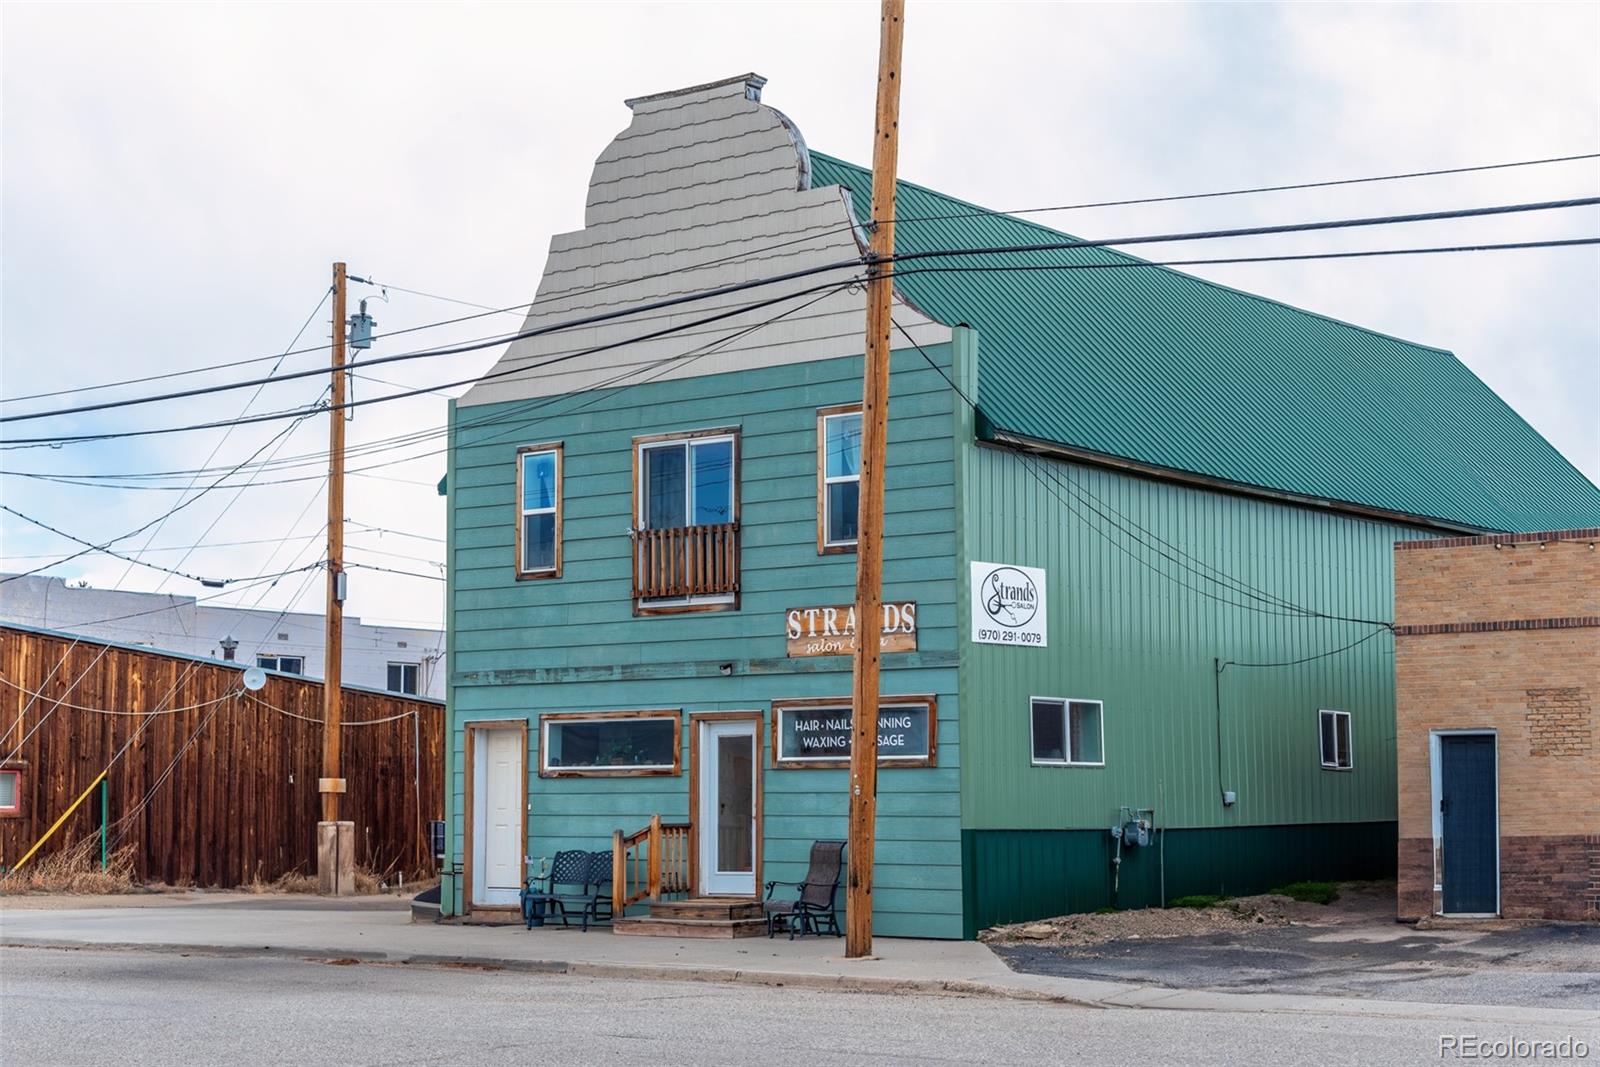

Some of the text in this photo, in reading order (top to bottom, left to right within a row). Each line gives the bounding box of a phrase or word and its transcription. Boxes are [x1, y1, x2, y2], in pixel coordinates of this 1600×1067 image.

[987, 573, 1035, 615] Strands
[1016, 602, 1035, 610] SALON
[788, 603, 916, 640] STRADS
[978, 629, 1041, 643] (970) 291-0079
[806, 638, 845, 654] salon
[795, 719, 820, 732] HAIR
[877, 716, 912, 729] NNING
[803, 734, 905, 748] WAXING SAGE
